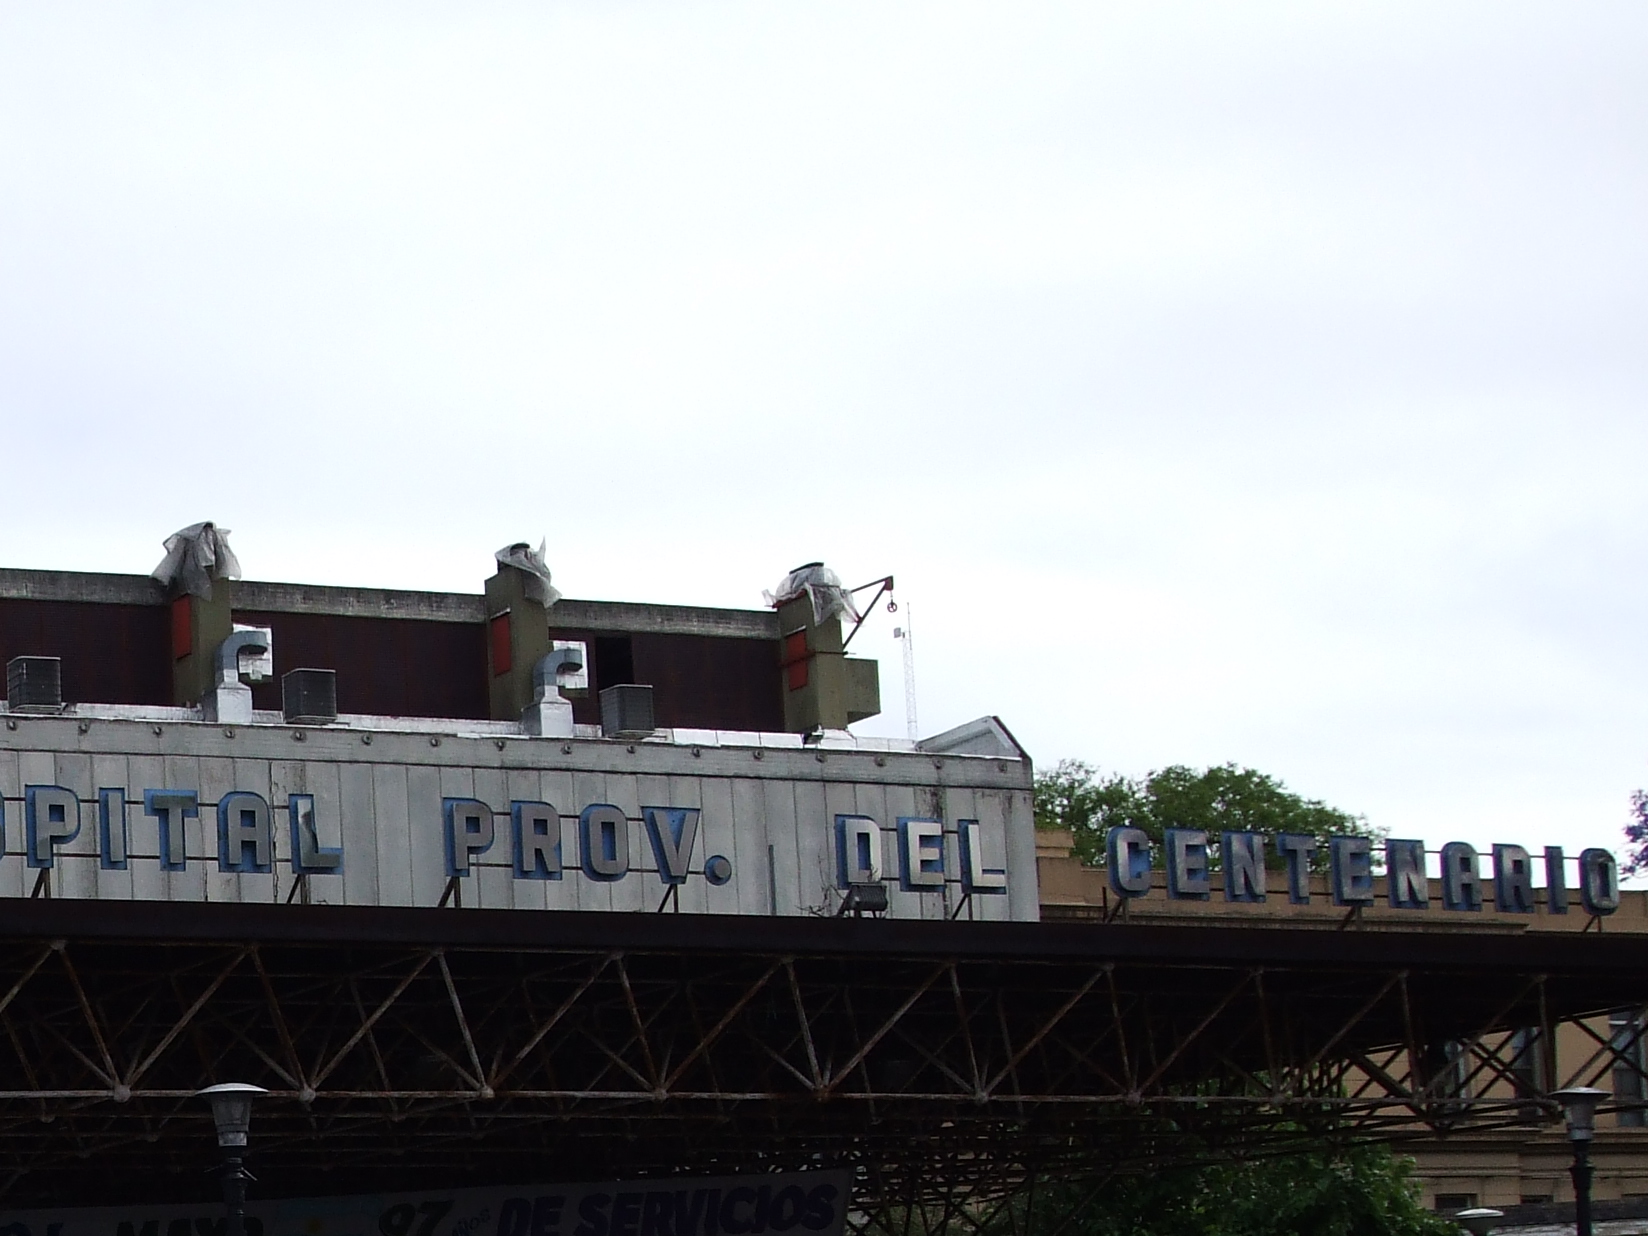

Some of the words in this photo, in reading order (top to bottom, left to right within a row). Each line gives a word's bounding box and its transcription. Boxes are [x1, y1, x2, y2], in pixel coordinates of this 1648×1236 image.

[442, 797, 732, 885] PROV.
[834, 814, 1007, 895] DEL
[1106, 825, 1620, 916] CENTENARIO
